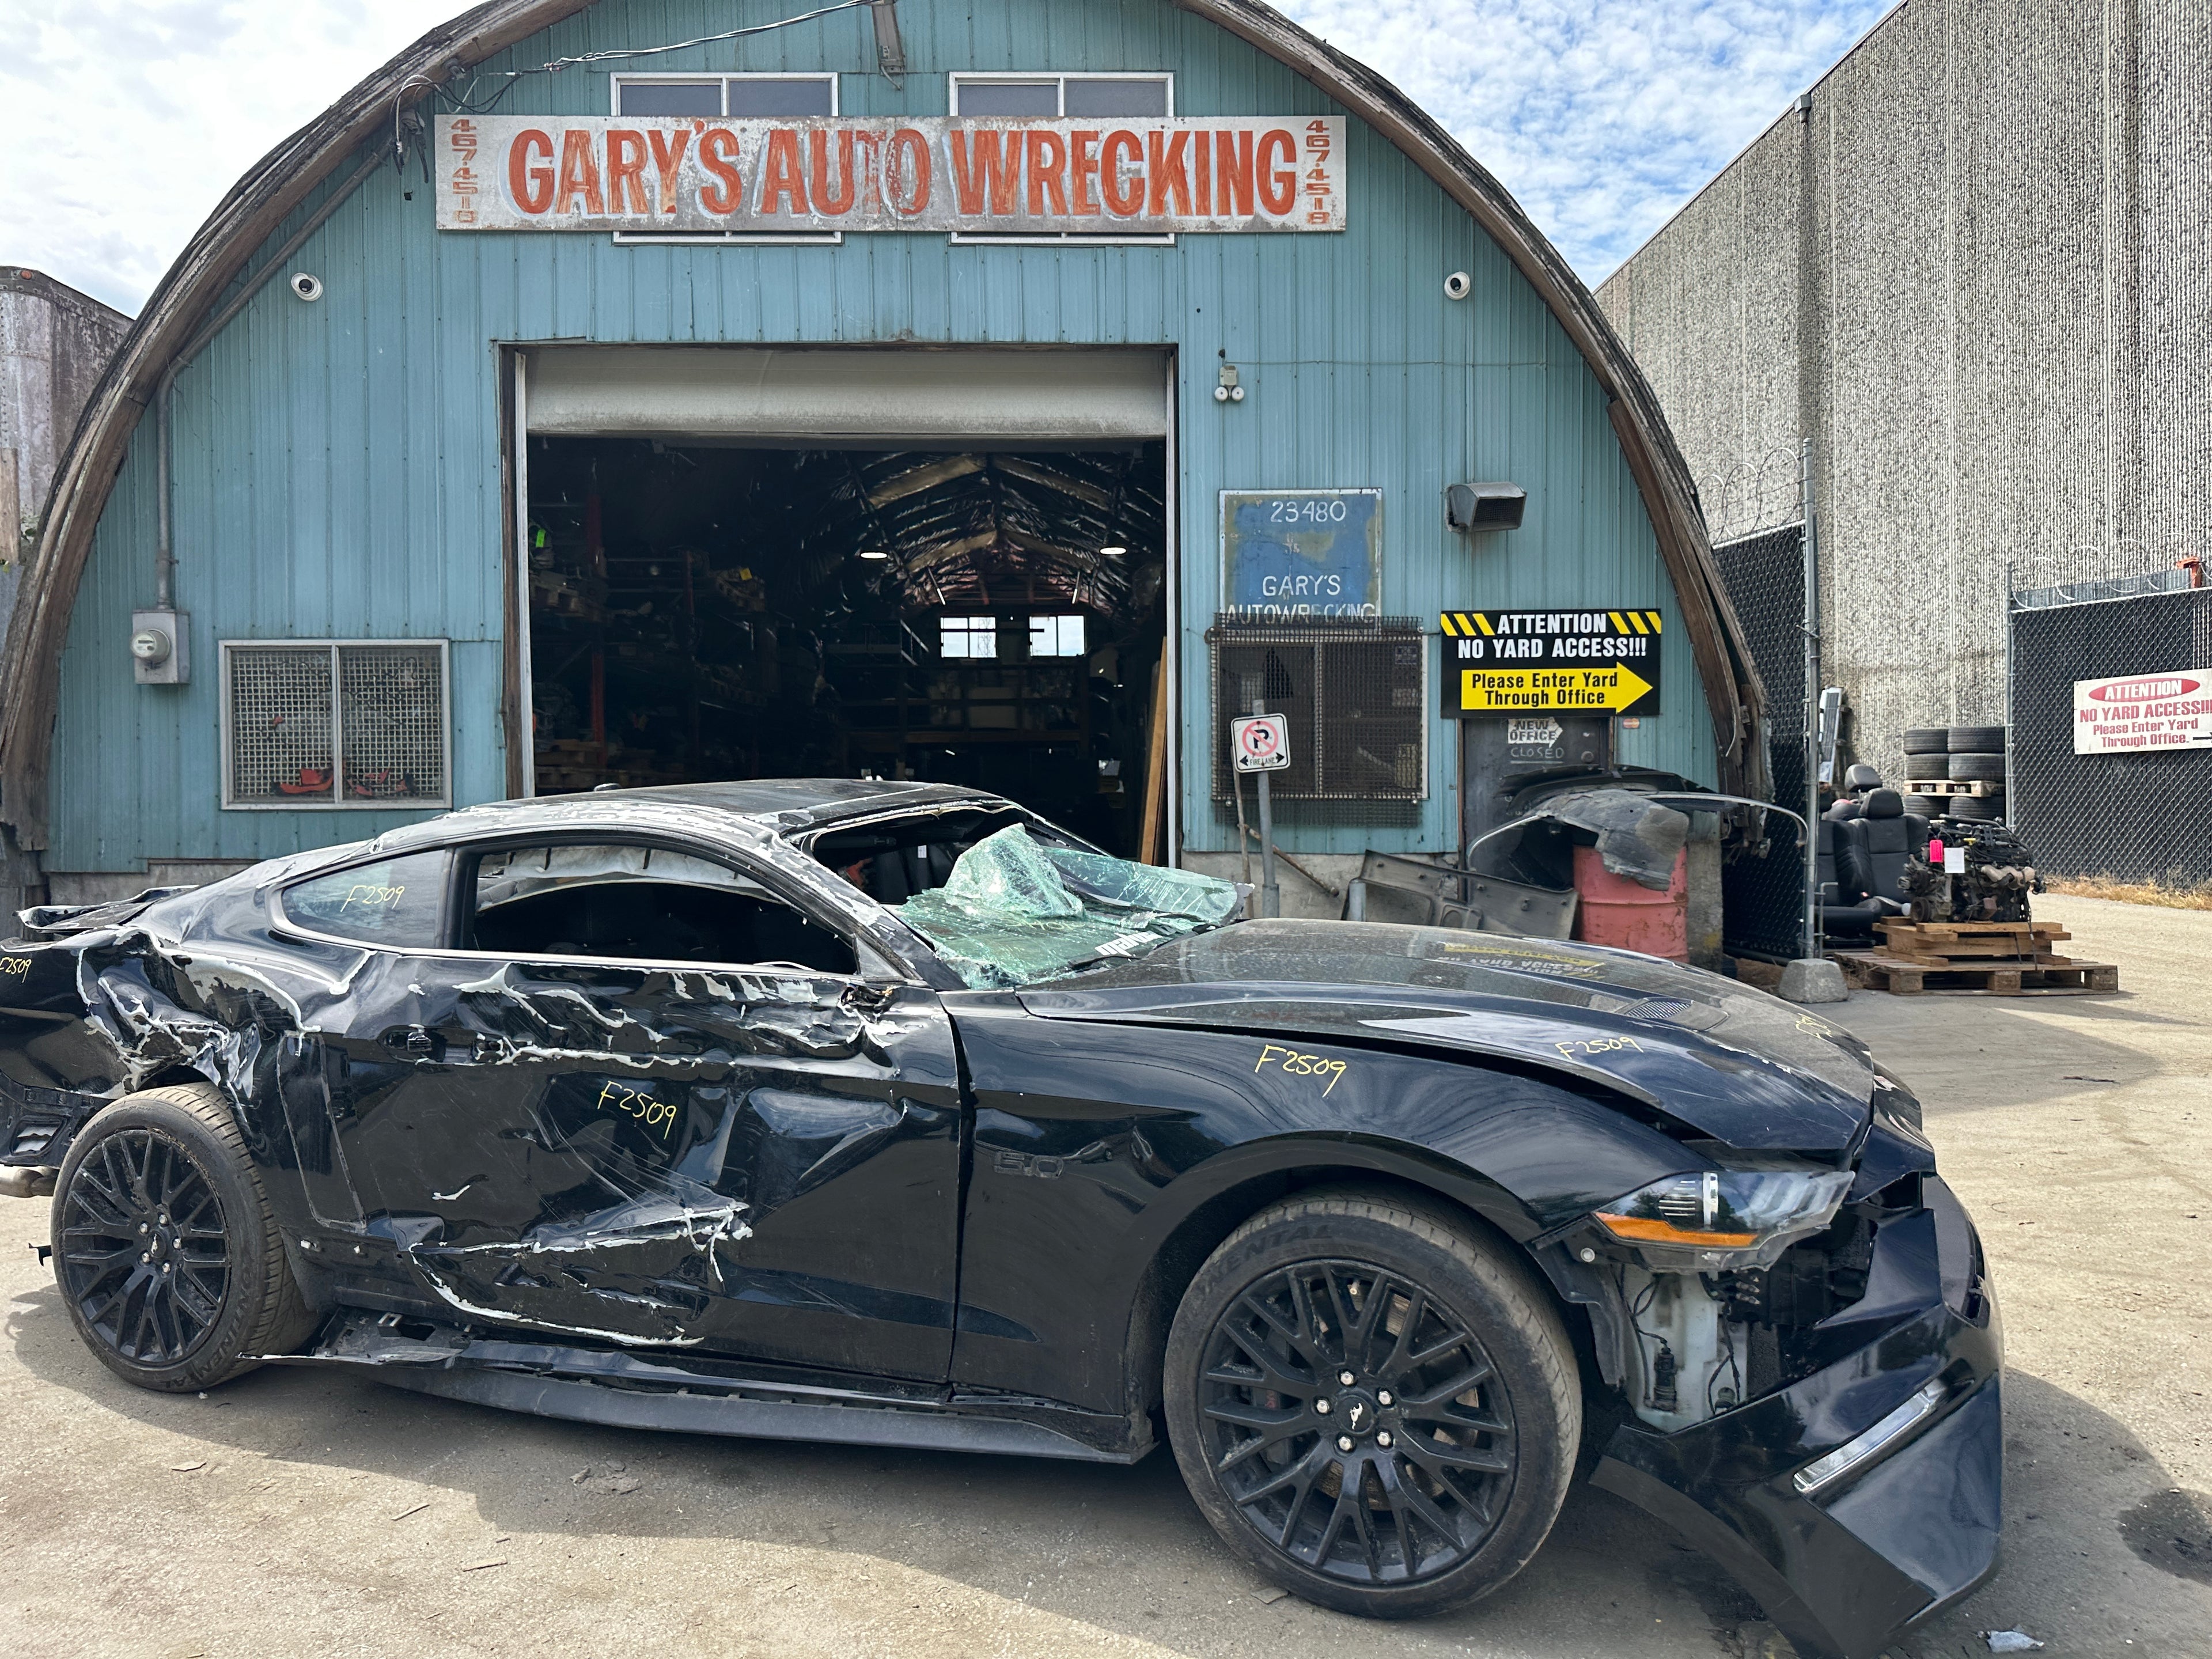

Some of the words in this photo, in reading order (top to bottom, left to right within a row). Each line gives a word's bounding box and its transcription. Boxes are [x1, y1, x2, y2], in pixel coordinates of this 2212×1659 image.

[507, 120, 741, 215] GARY'S
[759, 128, 932, 215] AUTO
[949, 128, 1297, 216] WRECKING
[1270, 500, 1347, 522] 23480
[1262, 575, 1341, 596] GARY'S
[1497, 613, 1607, 634] ATTENTION
[1458, 639, 1484, 658] NO
[1493, 638, 1543, 658] YARD
[1551, 637, 1646, 657] ACCESS!!!
[1472, 673, 1524, 688] Please
[1532, 672, 1575, 688] Enter
[1582, 672, 1618, 687] Yard
[2104, 680, 2182, 700] ATTENTION
[1484, 690, 1549, 708] Through
[1557, 689, 1605, 704] Office
[2080, 709, 2097, 722] NO
[2101, 704, 2139, 720] YARD
[1516, 719, 1549, 730] NEW
[2093, 724, 2128, 735] Please
[2132, 721, 2164, 733] Enter
[2168, 718, 2198, 730] Yard
[1510, 729, 1556, 741] OFFICE
[2101, 736, 2147, 748] Through
[1250, 758, 1260, 766] FIRE
[1510, 747, 1564, 759] CLOSED
[340, 885, 405, 912] F2509
[1555, 1036, 1644, 1060] F2509
[1255, 1044, 1347, 1098] F2509
[597, 1080, 677, 1140] F2509
